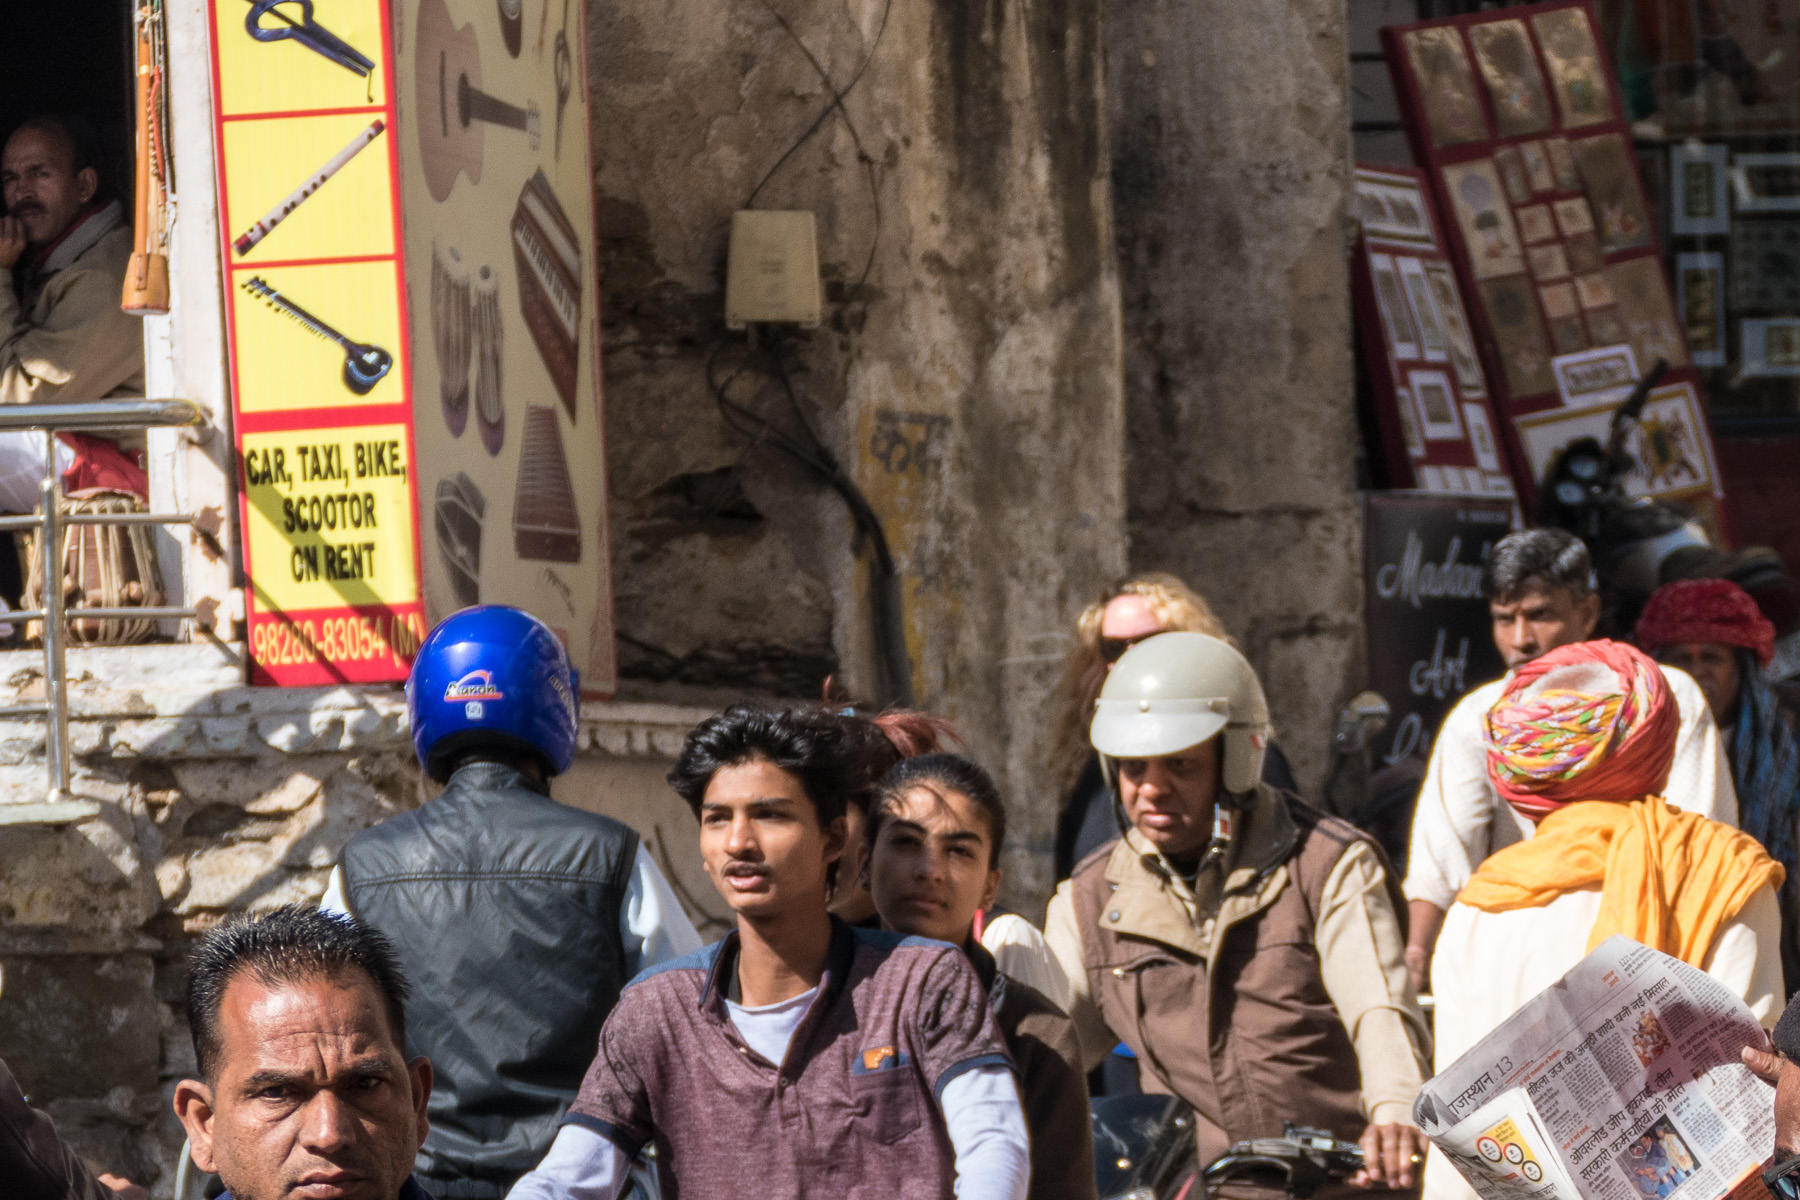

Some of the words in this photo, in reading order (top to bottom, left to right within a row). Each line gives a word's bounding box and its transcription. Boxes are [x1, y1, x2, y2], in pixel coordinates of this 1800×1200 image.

[246, 448, 293, 491] CAR,
[296, 443, 349, 488] TAXI,
[353, 440, 406, 484] BIKE,
[282, 493, 377, 533] SCOOTOR
[291, 545, 318, 584] ON
[324, 542, 376, 581] RENT
[253, 616, 385, 667] 98280-83054
[1548, 1062, 1564, 1078] जज
[1563, 1051, 1576, 1064] की
[1575, 1032, 1597, 1056] अनूठी
[1596, 1019, 1615, 1037] शादी
[1614, 1006, 1631, 1022] बनी
[1631, 993, 1645, 1009] नई
[1643, 977, 1669, 1001] मिसाल
[1495, 1056, 1513, 1076] 13
[1570, 1126, 1608, 1165] ओवरलोड
[1606, 1111, 1626, 1130] जीप
[1656, 1067, 1675, 1088] तीन
[1579, 1148, 1612, 1180] सरकारी
[1609, 1109, 1657, 1152] कर्मचारियों
[1651, 1098, 1666, 1113] की
[1664, 1081, 1685, 1102] मौत
